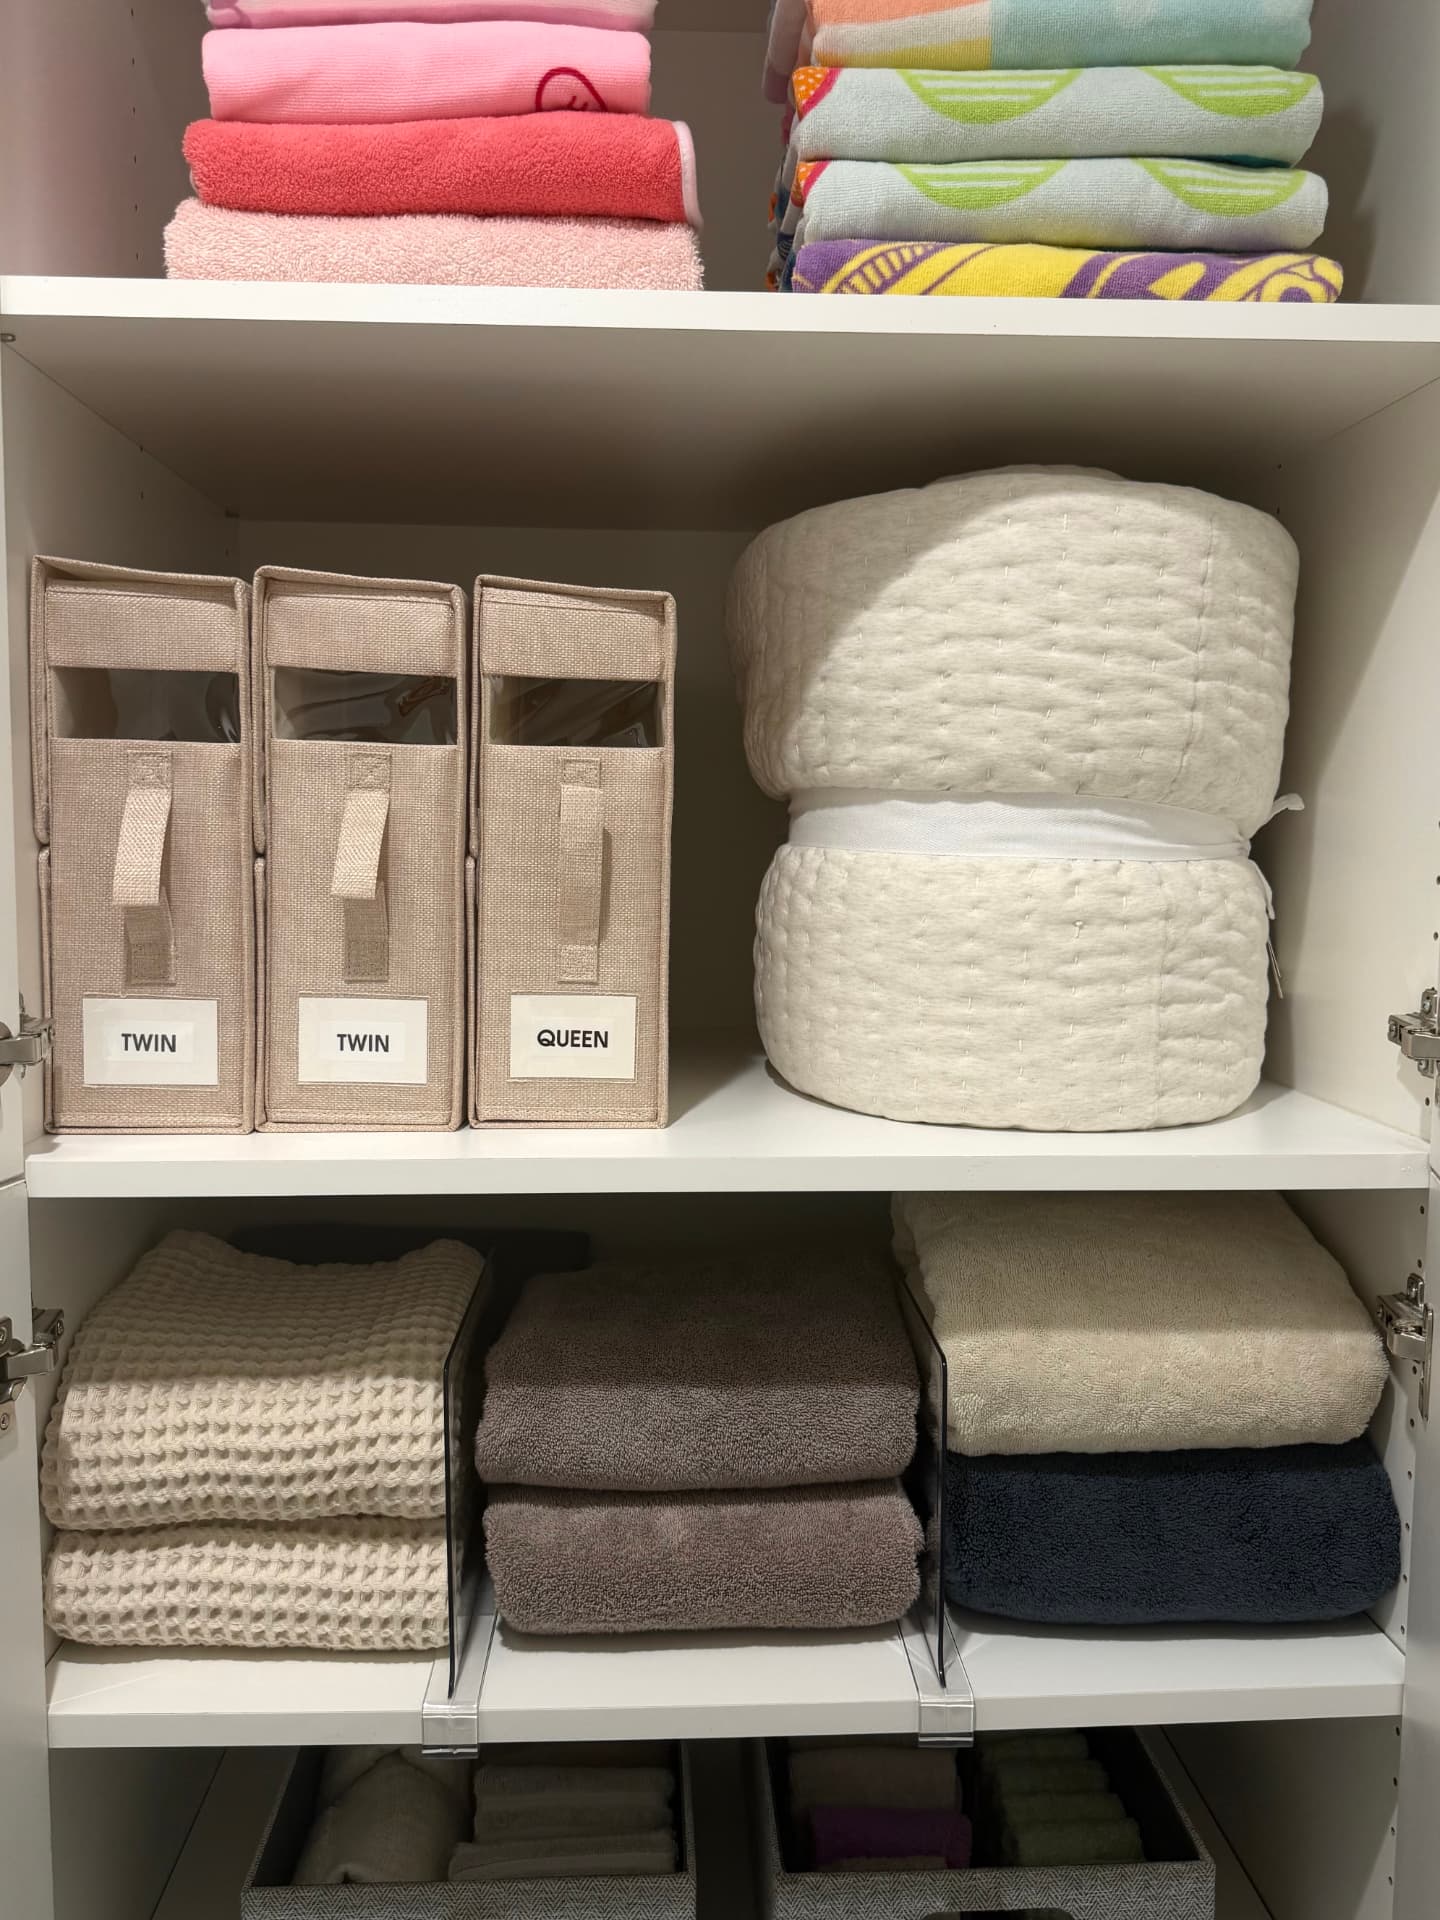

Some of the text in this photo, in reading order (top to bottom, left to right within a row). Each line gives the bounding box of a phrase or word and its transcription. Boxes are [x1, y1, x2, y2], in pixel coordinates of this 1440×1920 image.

[121, 1033, 176, 1053] TWIN
[336, 1033, 389, 1053] TWIN
[536, 1029, 609, 1049] QUEEN
